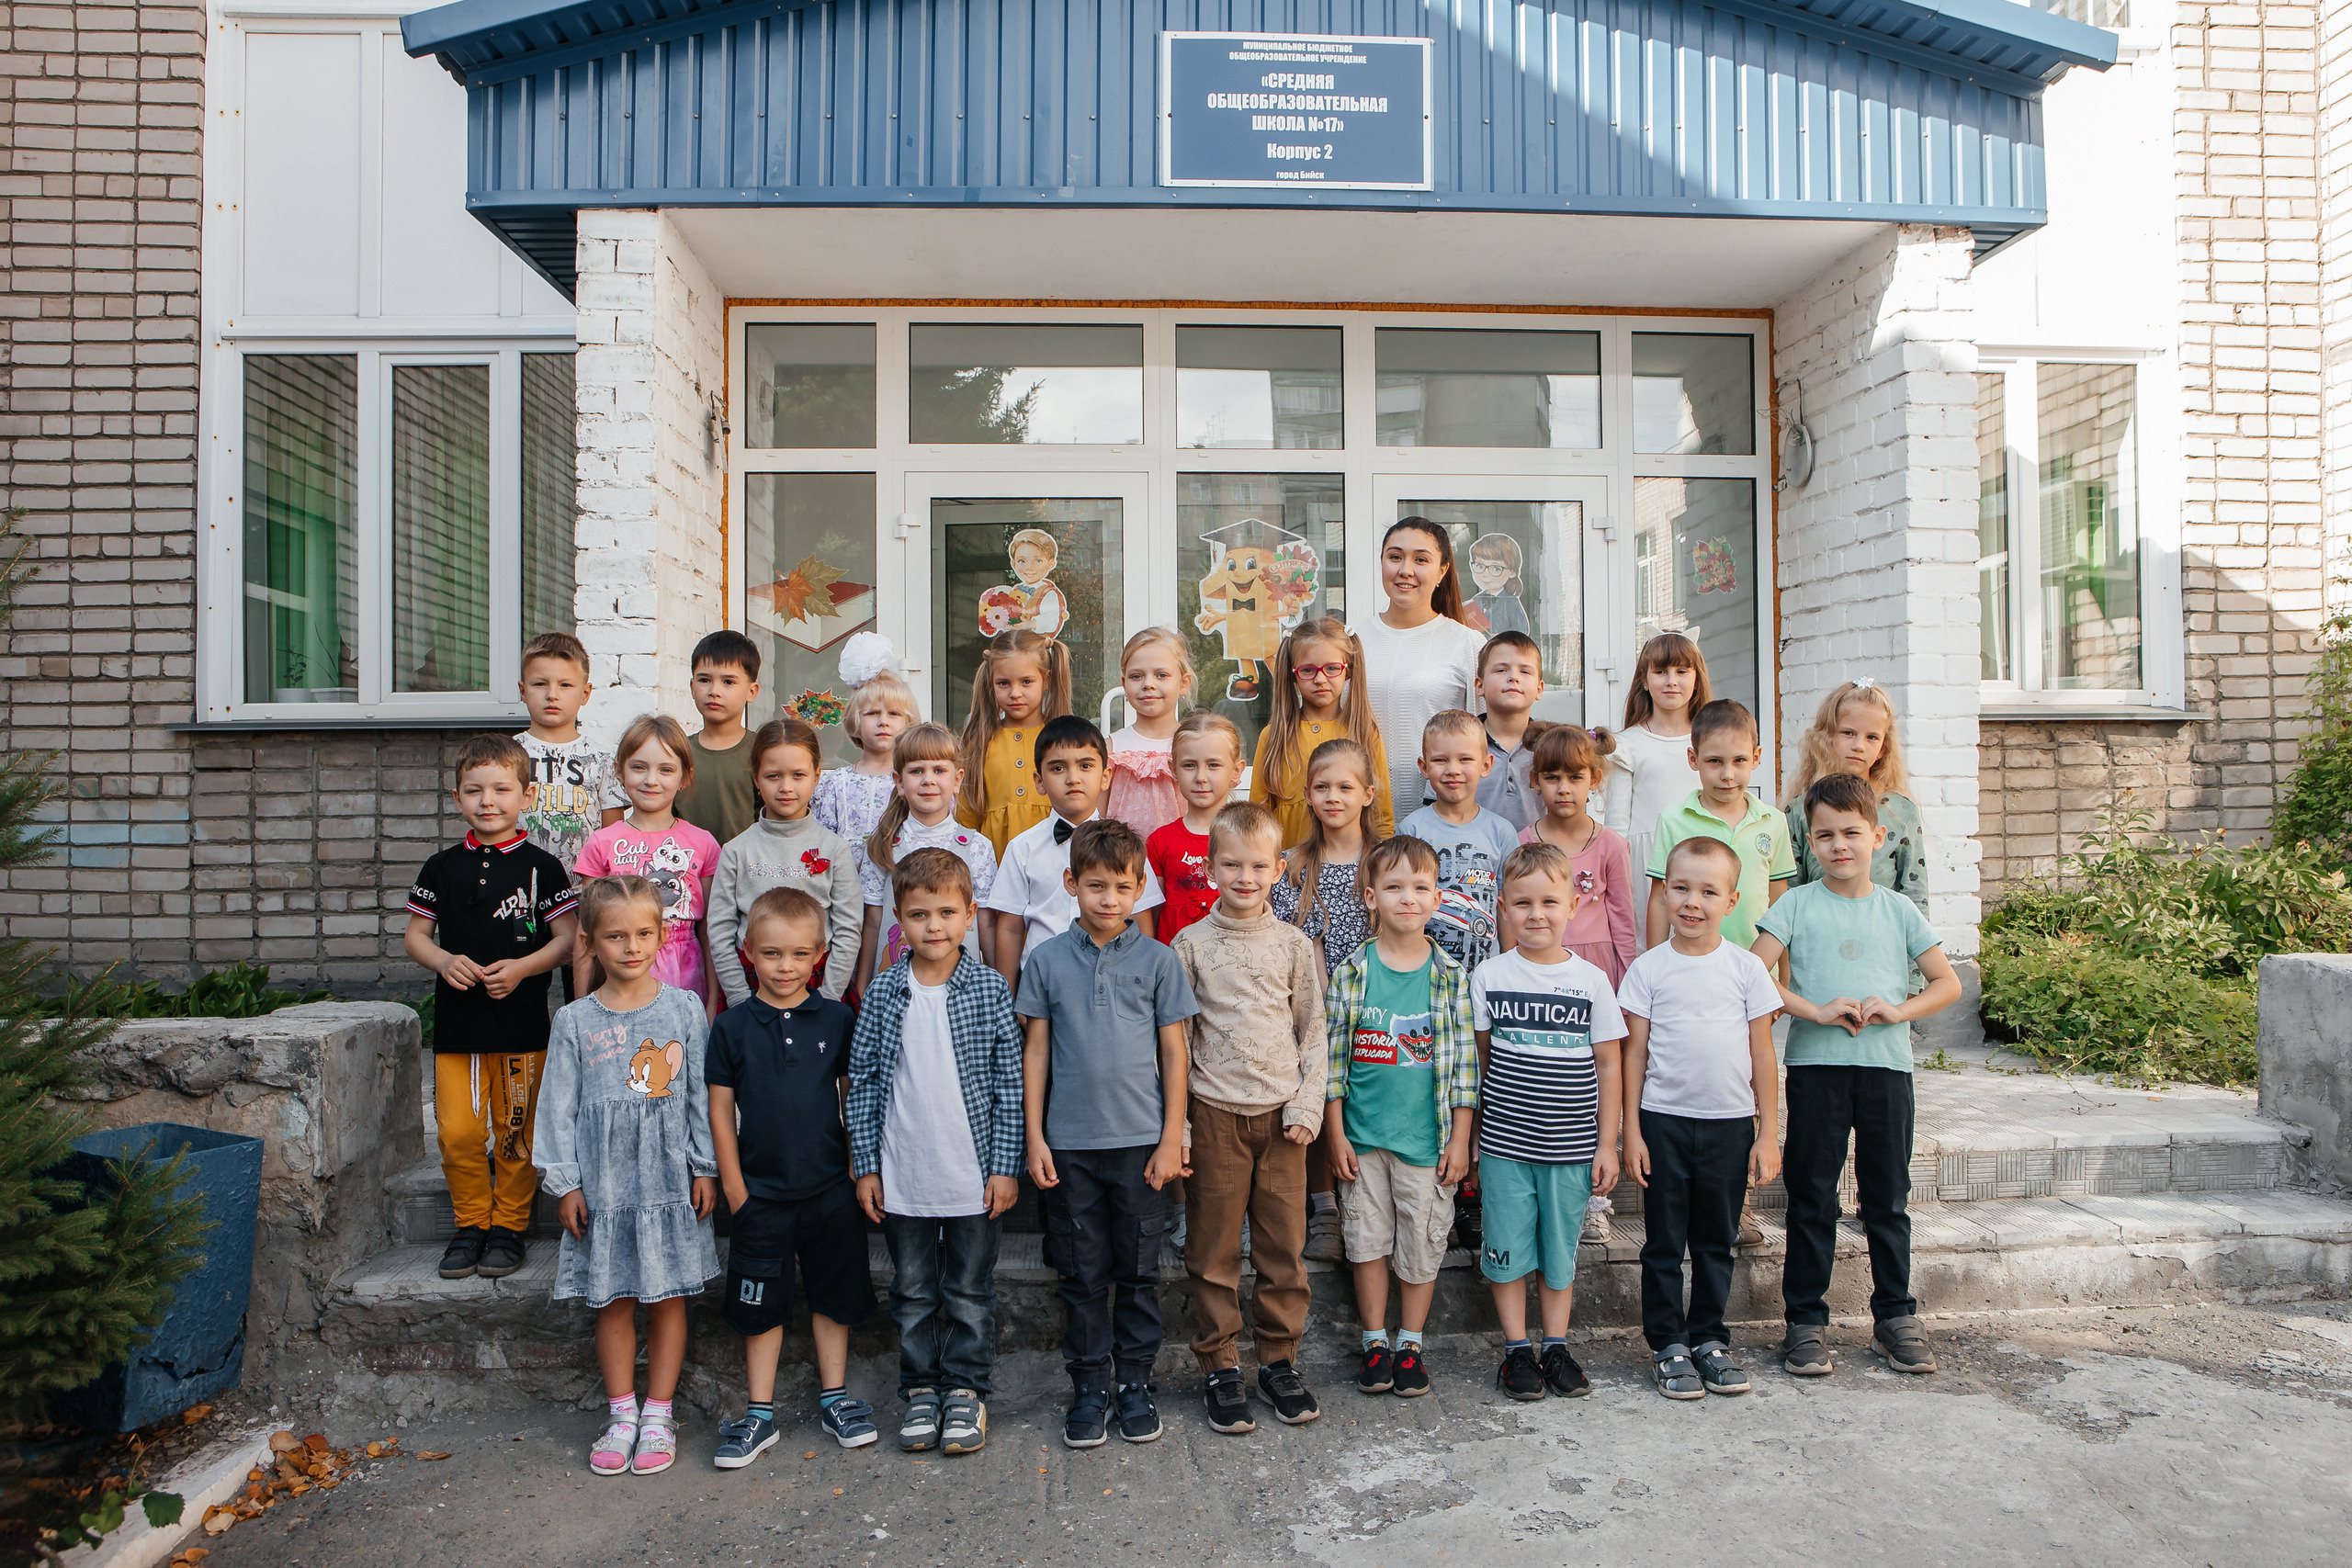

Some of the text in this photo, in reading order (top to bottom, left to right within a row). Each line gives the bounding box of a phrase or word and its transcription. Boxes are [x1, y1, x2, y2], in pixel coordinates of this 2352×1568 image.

[1243, 41, 1353, 53] МУНИЦИПАЛЬНОЕ БЮДЖЕТНОЕ
[1229, 51, 1367, 64] ОБЩЕОБРАЗОВАТЕЛЬНОЕ УЧРЕЖДЕНИЕ
[1261, 73, 1334, 91] «СРЕДНЯЯ
[1207, 93, 1388, 113] ОБЩЕОБРАЗОВАТЕЛЬНАЯ
[1252, 116, 1306, 131] ШКОЛА
[1267, 142, 1333, 161] Корпус 2
[1276, 170, 1325, 180] город Бийск
[530, 756, 584, 785] IT'S
[613, 839, 650, 856] Cat
[614, 855, 639, 869] day
[1486, 1000, 1590, 1025] NAUTICAL
[582, 1024, 628, 1051] Jerry
[601, 1038, 616, 1049] the
[1353, 1032, 1397, 1048] HISTORIA
[588, 1045, 625, 1067] mouse
[1354, 1047, 1393, 1059] EXPLICADA
[510, 1105, 524, 1126] 98
